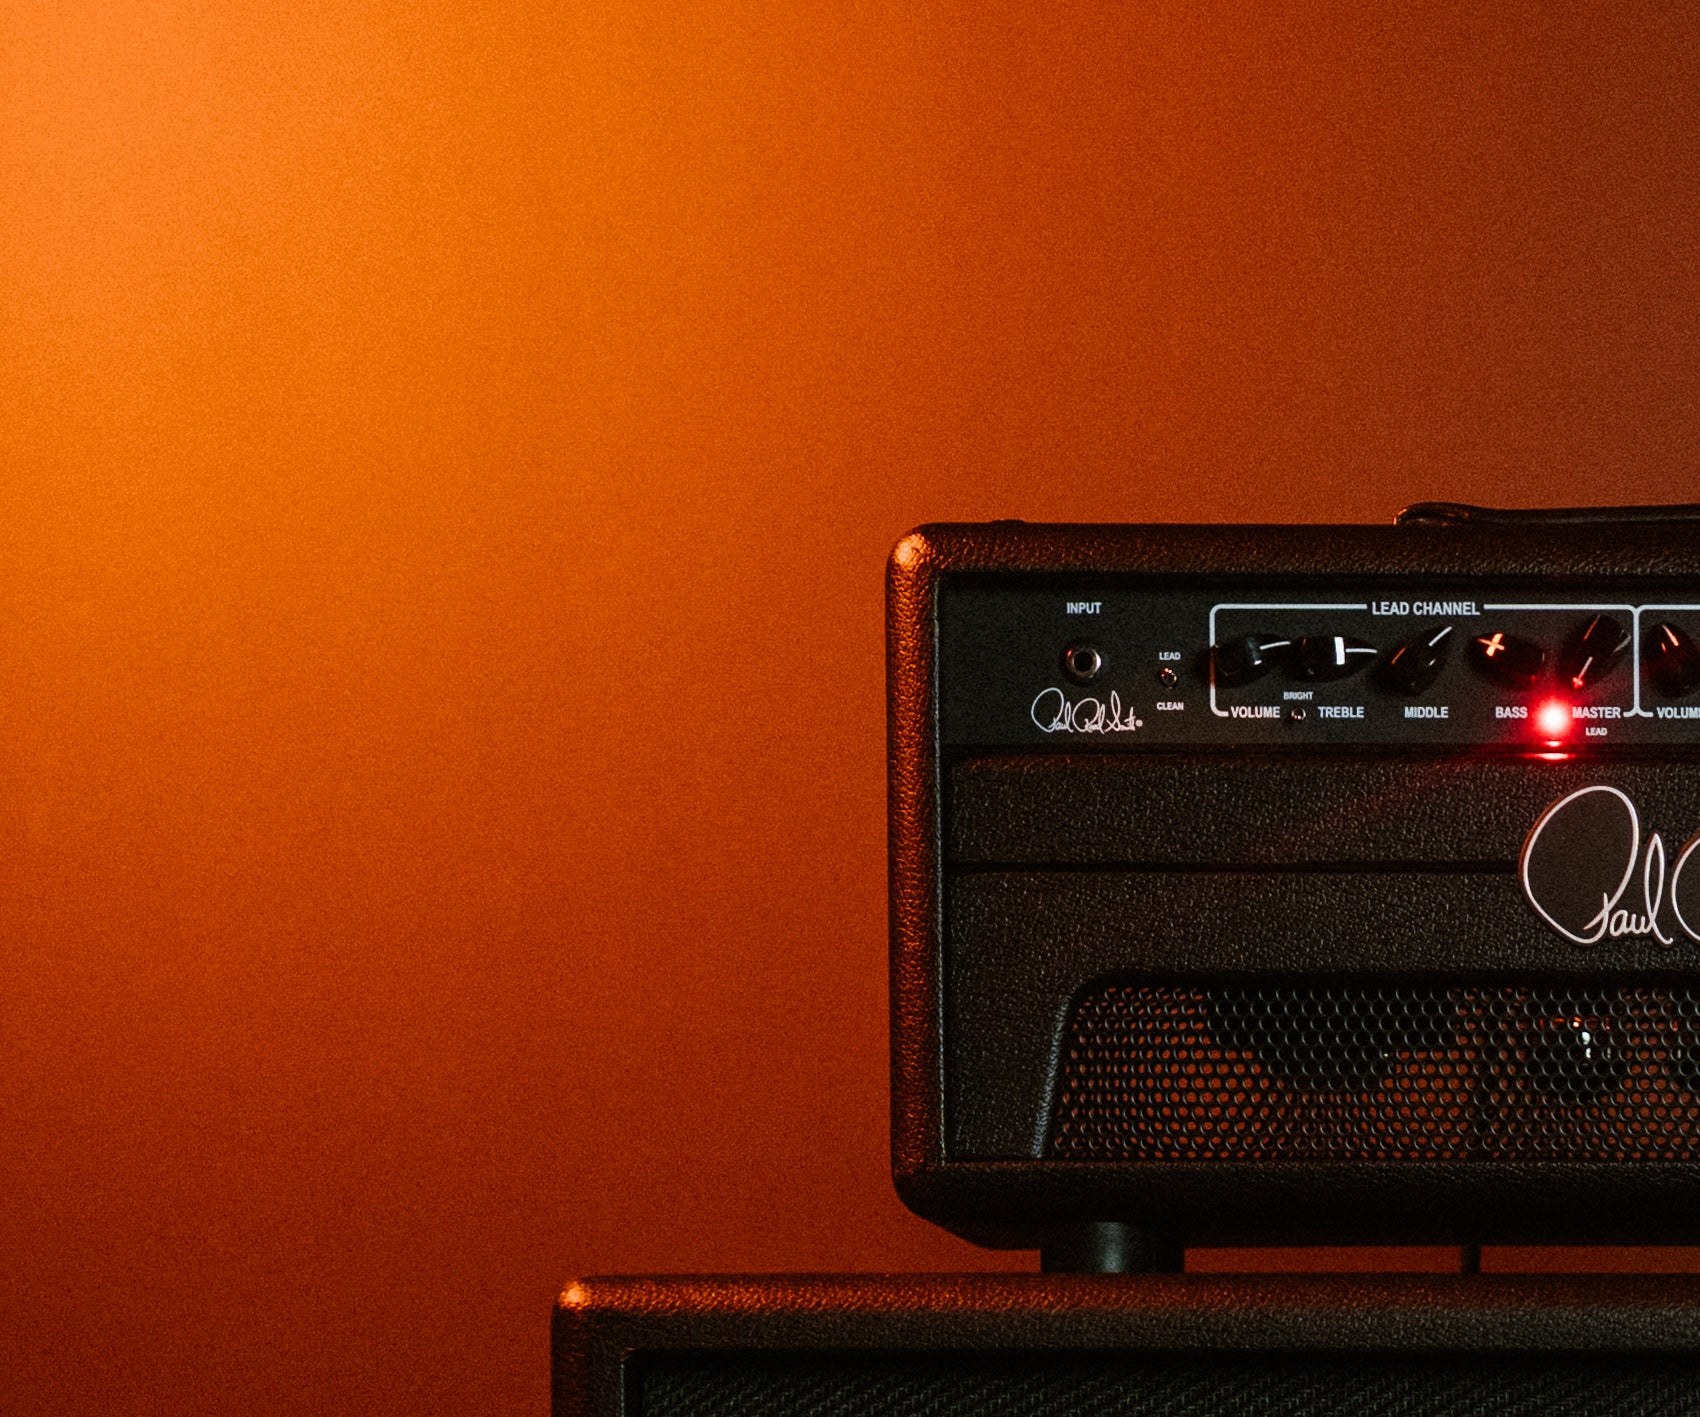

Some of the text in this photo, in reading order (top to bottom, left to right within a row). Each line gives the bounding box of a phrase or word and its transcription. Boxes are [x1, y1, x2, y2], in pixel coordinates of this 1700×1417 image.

[1066, 602, 1102, 615] INPUT
[1371, 602, 1481, 615] LEAD CHANNEL
[1158, 652, 1181, 661] LEAD
[1283, 691, 1314, 701] BRIGHT
[1156, 702, 1184, 711] CLEAN
[1230, 706, 1281, 719] VOLUME
[1317, 706, 1365, 719] TREBLE
[1404, 706, 1449, 719] MIDDLE
[1495, 706, 1529, 719] BASS
[1572, 706, 1621, 719] MASTER
[1585, 727, 1608, 736] LEAD
[1522, 785, 1674, 946] Paul
